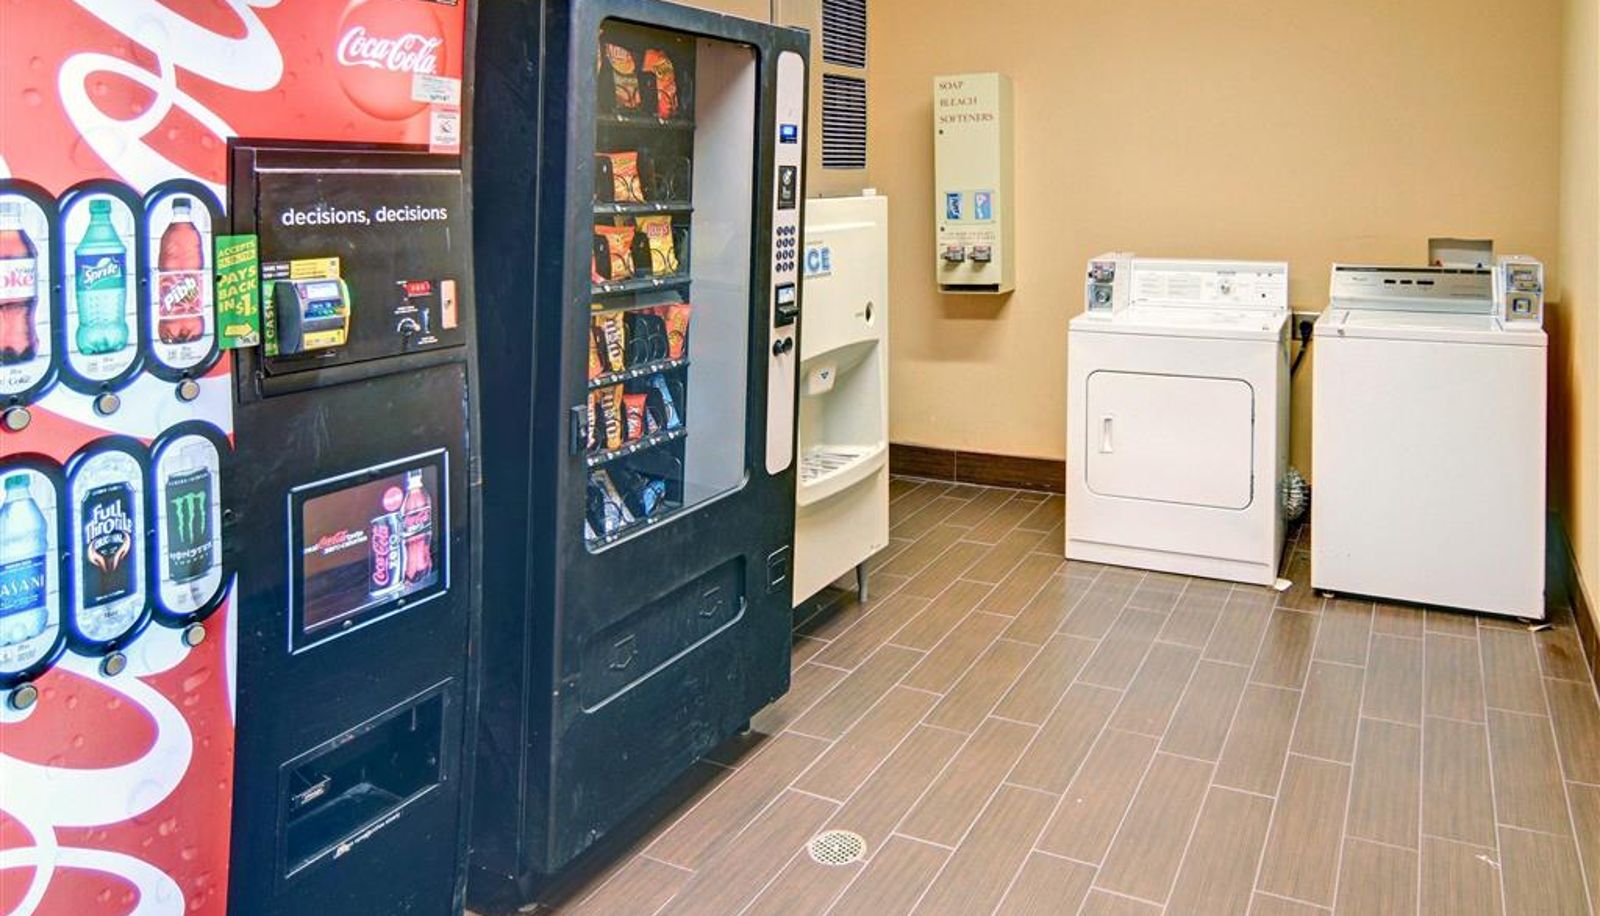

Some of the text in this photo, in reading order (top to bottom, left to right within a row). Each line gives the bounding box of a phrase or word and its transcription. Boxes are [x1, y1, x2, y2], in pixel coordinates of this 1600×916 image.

[337, 26, 443, 74] Coca-Cola
[939, 81, 963, 90] SOAP
[940, 96, 977, 107] BLEACH
[940, 112, 993, 123] SOFTENERS
[282, 205, 448, 226] decisions, decisions
[218, 241, 256, 258] ACCEPTS
[83, 261, 119, 285] Sprite
[219, 265, 257, 287] PAYS
[163, 277, 198, 312] Pibb
[218, 279, 257, 302] BACK
[218, 299, 235, 314] IN
[264, 299, 275, 338] CASH
[93, 499, 121, 524] Full
[85, 511, 133, 543] Throttle
[372, 525, 390, 586] Coca-Cola
[389, 534, 399, 570] zero
